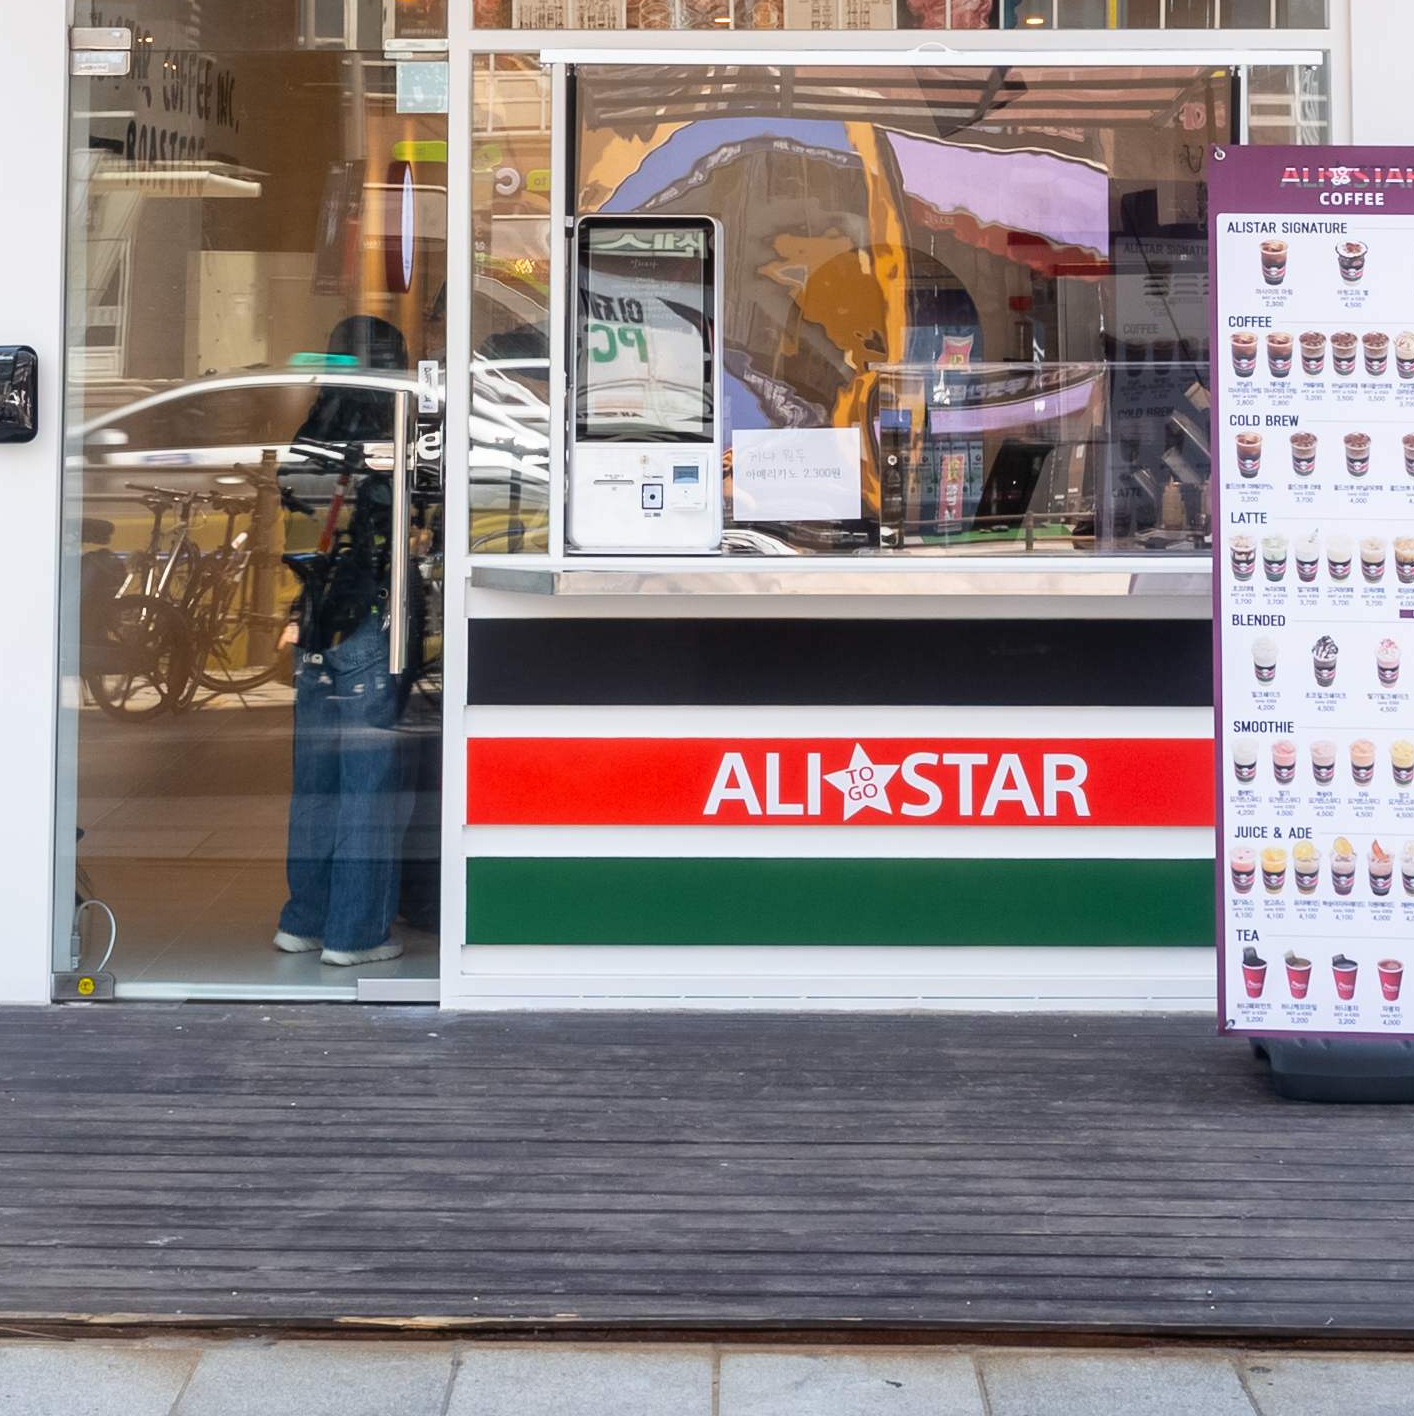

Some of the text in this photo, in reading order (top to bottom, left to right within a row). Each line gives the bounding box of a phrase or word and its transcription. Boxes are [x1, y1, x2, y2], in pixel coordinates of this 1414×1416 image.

[1319, 192, 1385, 206] COFFEE
[1227, 222, 1347, 233] ALISTAR SIGNATURE
[1229, 316, 1271, 327] COFFEE
[1230, 415, 1298, 426] COLD BREW
[745, 467, 799, 481] 아메리카노
[1231, 512, 1267, 524] LATTE
[1232, 614, 1285, 626] BLENDED
[1234, 721, 1293, 733] SMOOTHIE
[846, 765, 875, 782] TO
[847, 782, 880, 802] GO
[1235, 826, 1312, 839] JUICE & ADE
[1236, 929, 1259, 941] TEA
